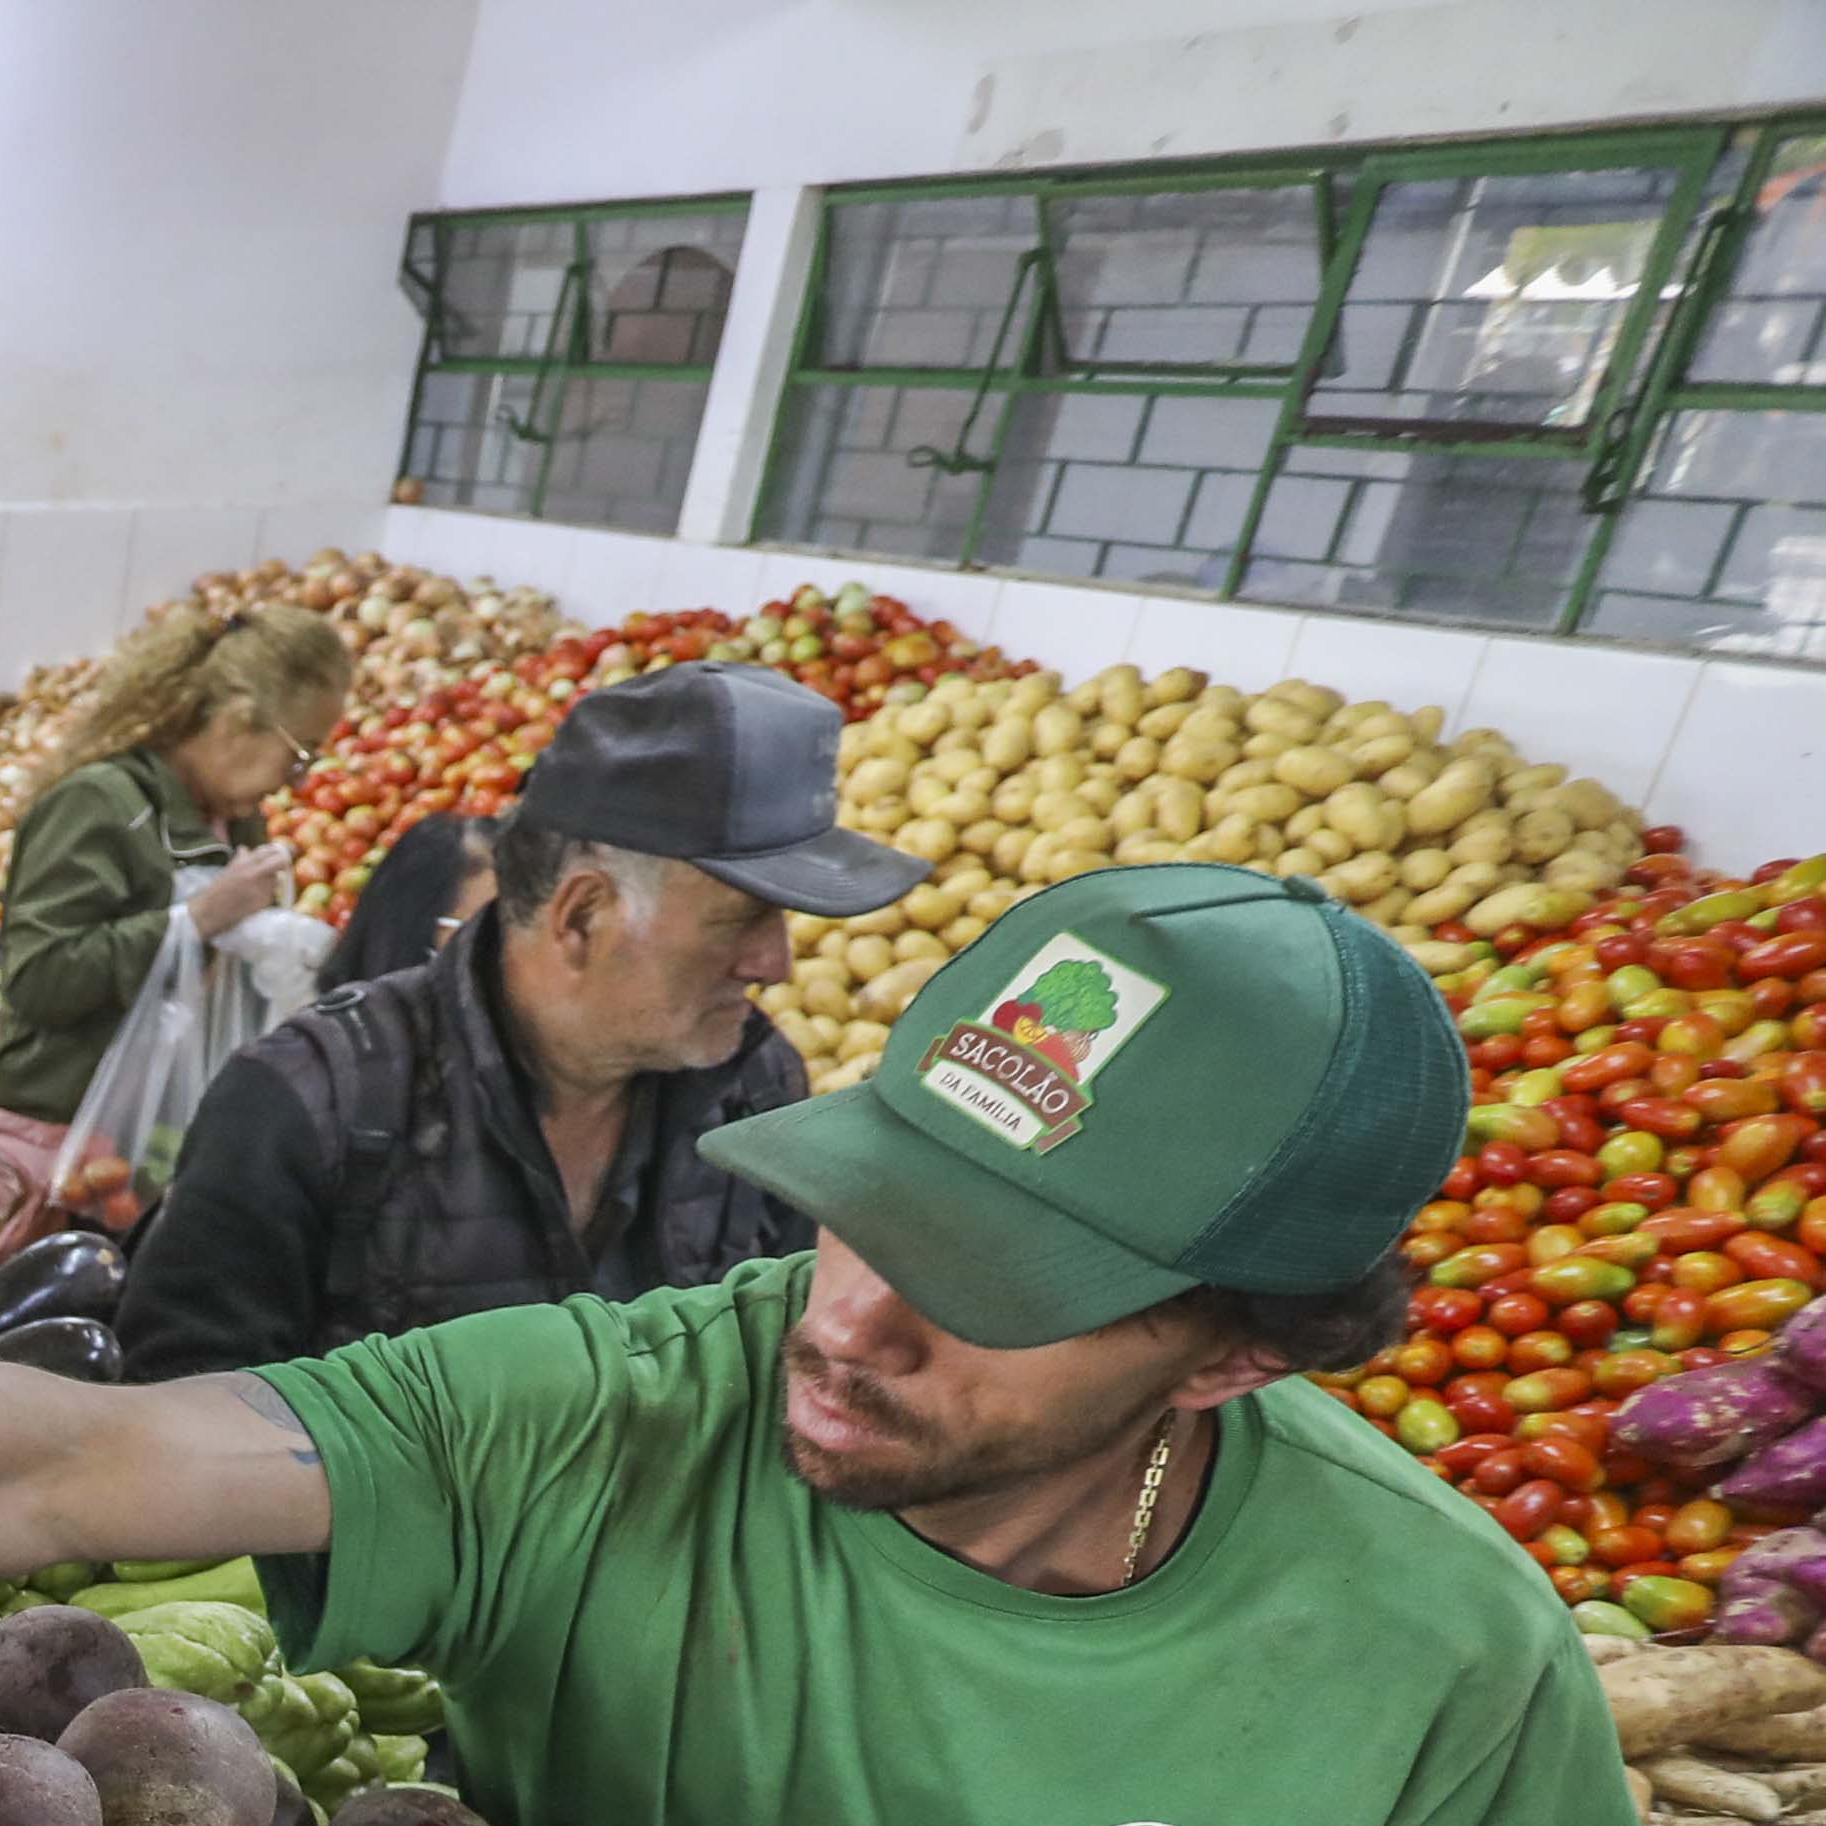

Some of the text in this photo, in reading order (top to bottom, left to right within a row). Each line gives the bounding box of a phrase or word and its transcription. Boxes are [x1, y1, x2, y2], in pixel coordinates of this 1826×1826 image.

[940, 1071, 1023, 1131] DA FAMÍLIA
[949, 1032, 1070, 1114] SACOLÃO
